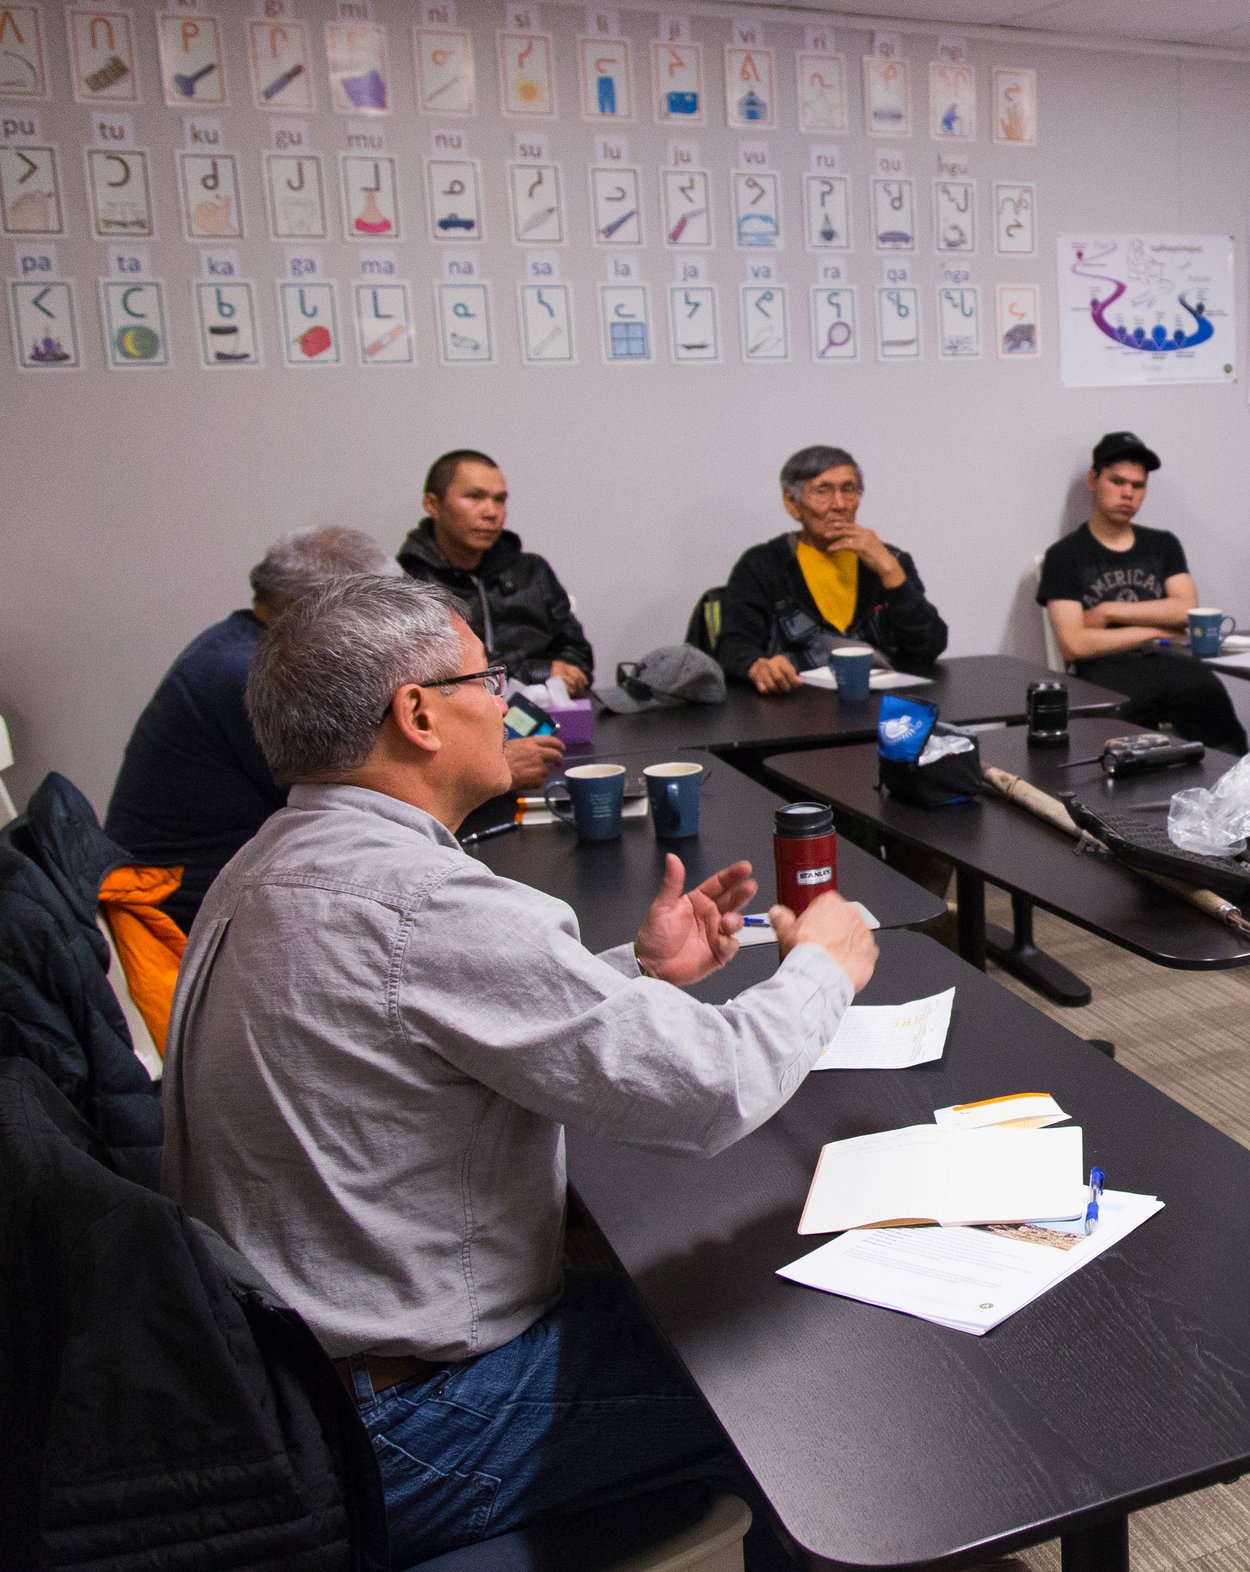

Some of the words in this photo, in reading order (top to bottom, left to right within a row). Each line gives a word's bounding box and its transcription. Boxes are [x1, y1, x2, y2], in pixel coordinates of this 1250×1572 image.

[428, 7, 449, 22] ni
[3, 119, 35, 137] pu
[98, 122, 125, 140] tu
[191, 122, 219, 144] ku
[275, 129, 302, 149] gu
[347, 133, 383, 149] mu
[434, 133, 462, 149] nu
[519, 143, 542, 158] su
[603, 141, 622, 160] lu
[673, 144, 691, 167] ju
[743, 151, 766, 165] vu
[816, 154, 835, 168] ru
[21, 254, 52, 275] pa
[116, 255, 142, 273] ta
[207, 256, 235, 276] ka
[290, 257, 317, 277] ga
[360, 259, 396, 275] ma
[448, 259, 474, 275] na
[531, 261, 554, 277] sa
[614, 258, 632, 278] la
[682, 262, 699, 282] ja
[751, 265, 772, 279] va
[823, 266, 842, 279] ra
[887, 268, 908, 284] qa
[1083, 568, 1163, 607] AMERICAN
[799, 869, 830, 879] STANLEY
